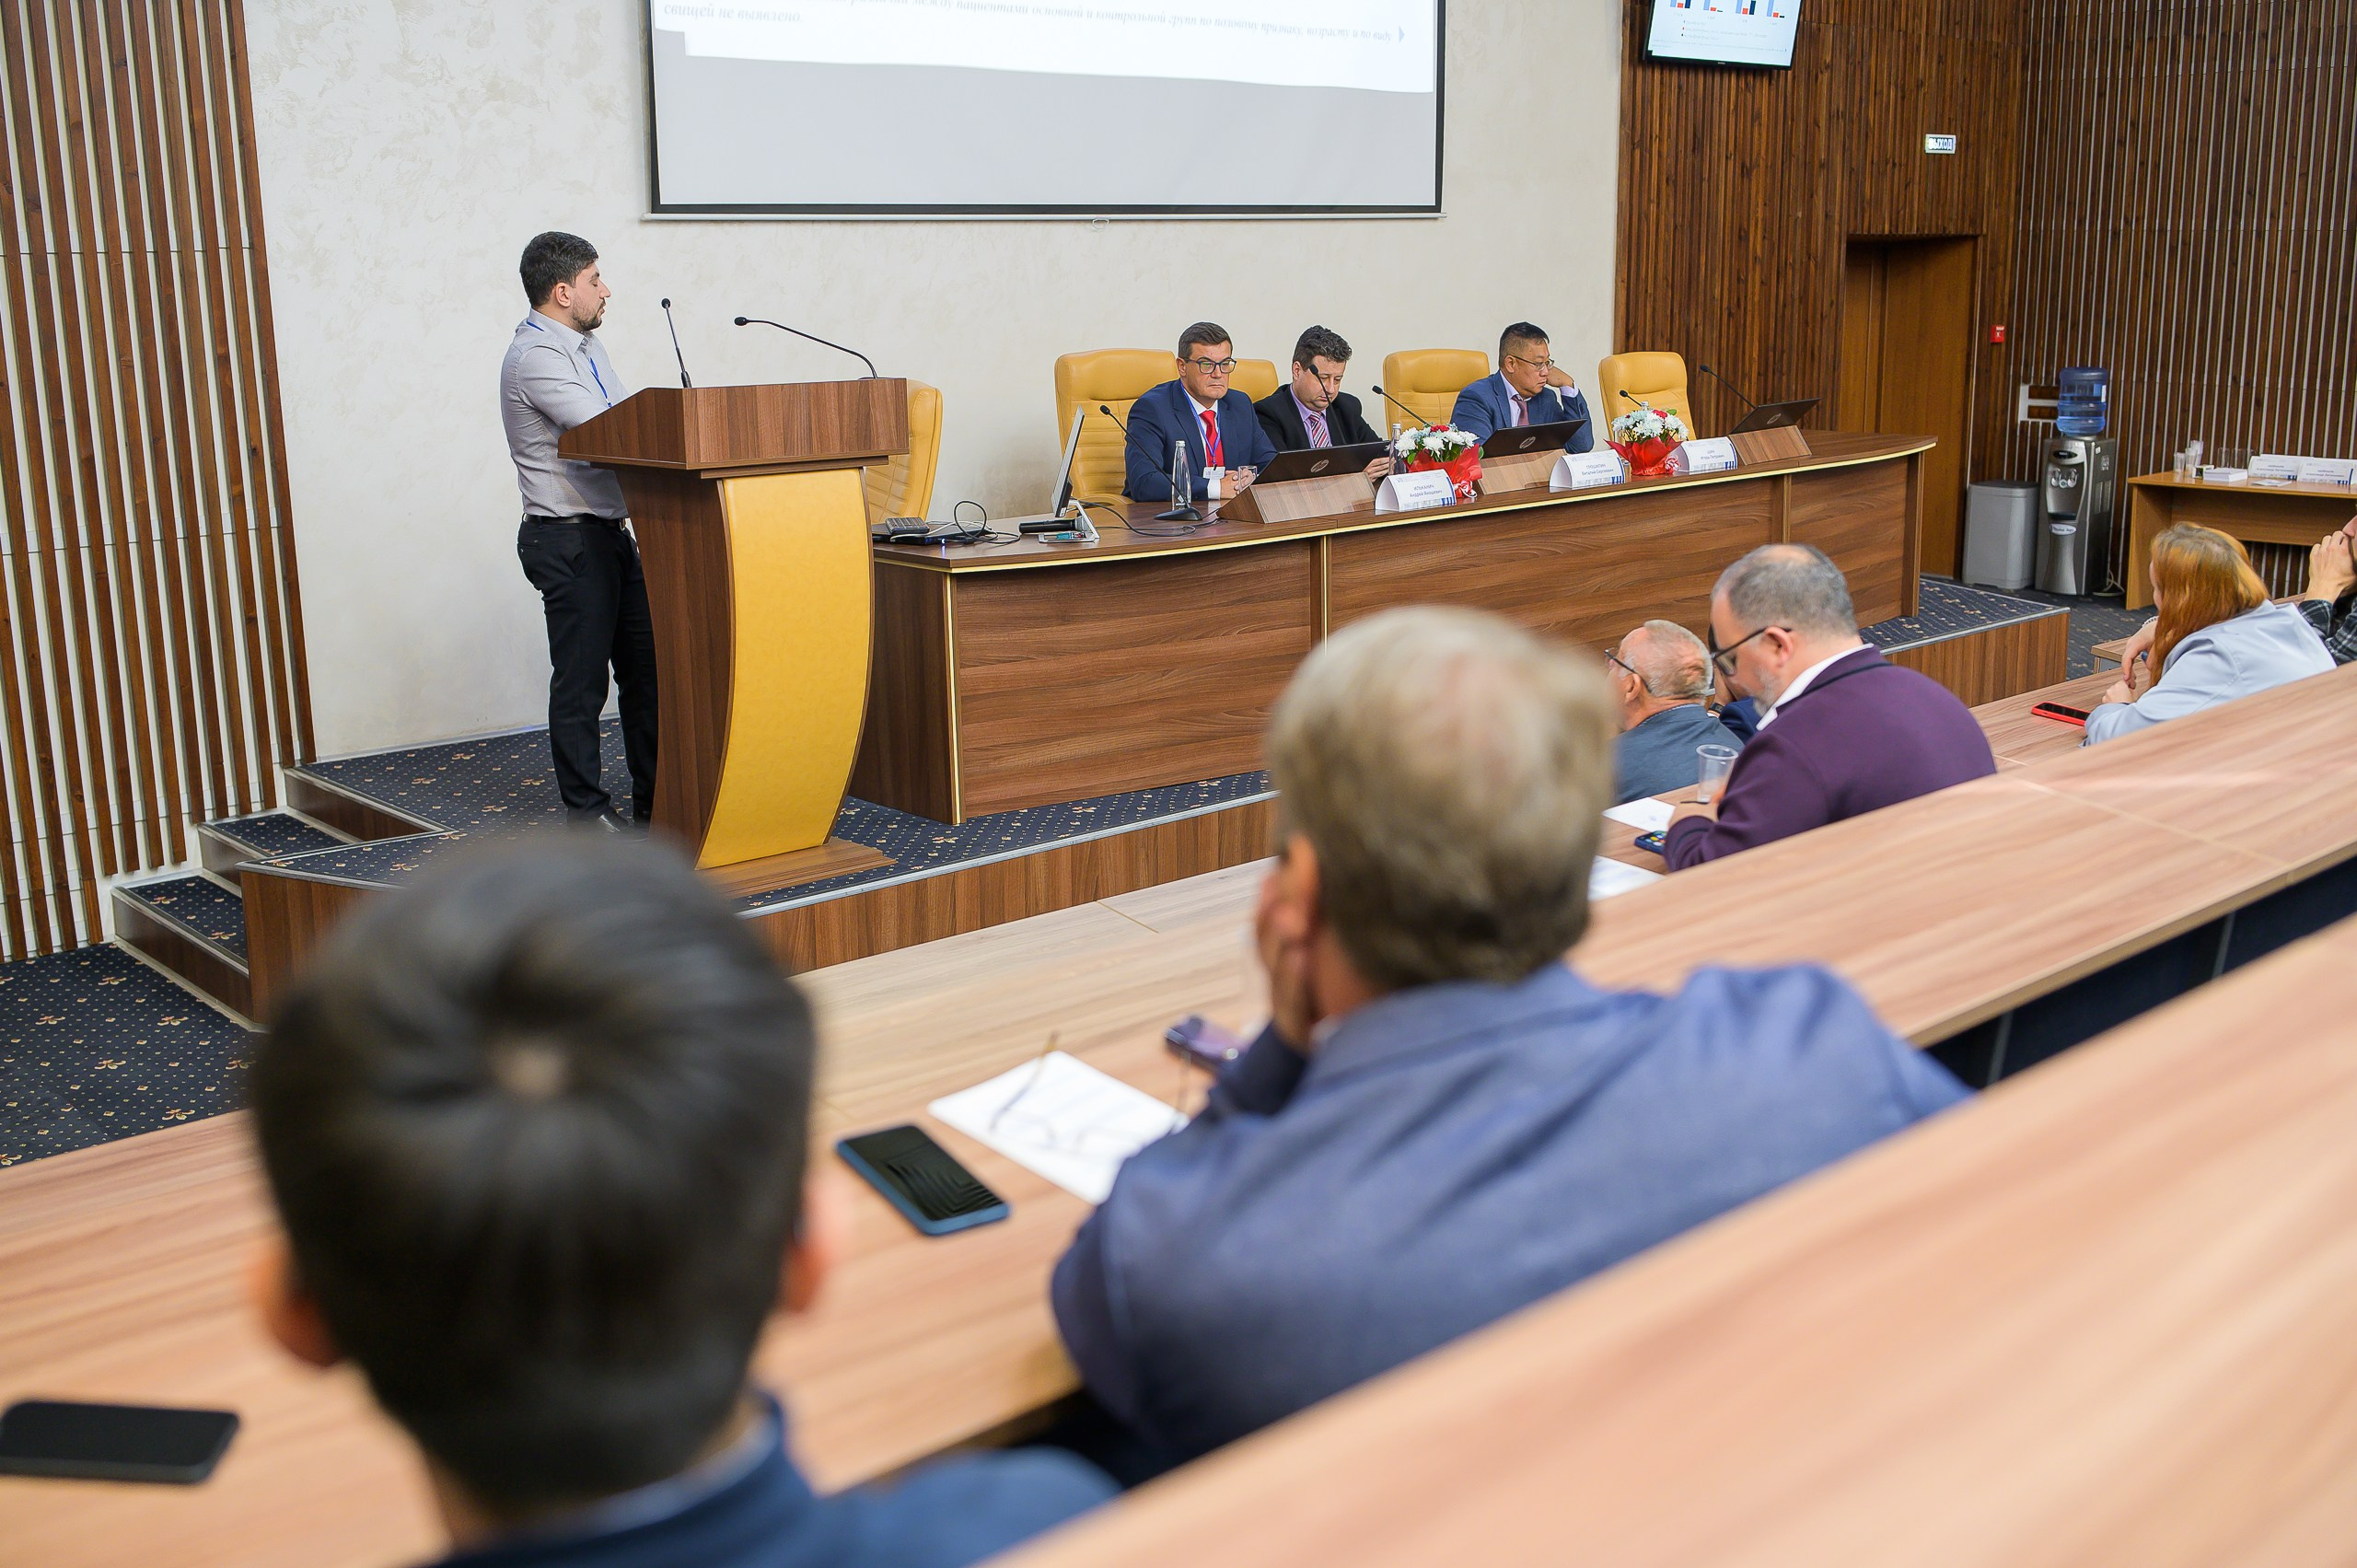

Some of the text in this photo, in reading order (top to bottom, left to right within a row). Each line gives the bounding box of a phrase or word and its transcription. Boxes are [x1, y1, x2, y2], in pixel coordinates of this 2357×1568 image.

[664, 3, 803, 23] свищей не выявлено.
[957, 0, 1028, 14] пациентами
[1032, 5, 1084, 18] основной
[1086, 10, 1093, 18] и
[1096, 9, 1167, 25] контрольной
[1168, 14, 1197, 28] групп
[1200, 17, 1212, 26] по
[1214, 17, 1259, 31] половому
[1260, 21, 1304, 37] признаку,
[1306, 27, 1350, 40] возрасту
[1360, 30, 1371, 39] по
[1373, 29, 1393, 43] виду
[1929, 137, 1953, 150] ВЫХОД
